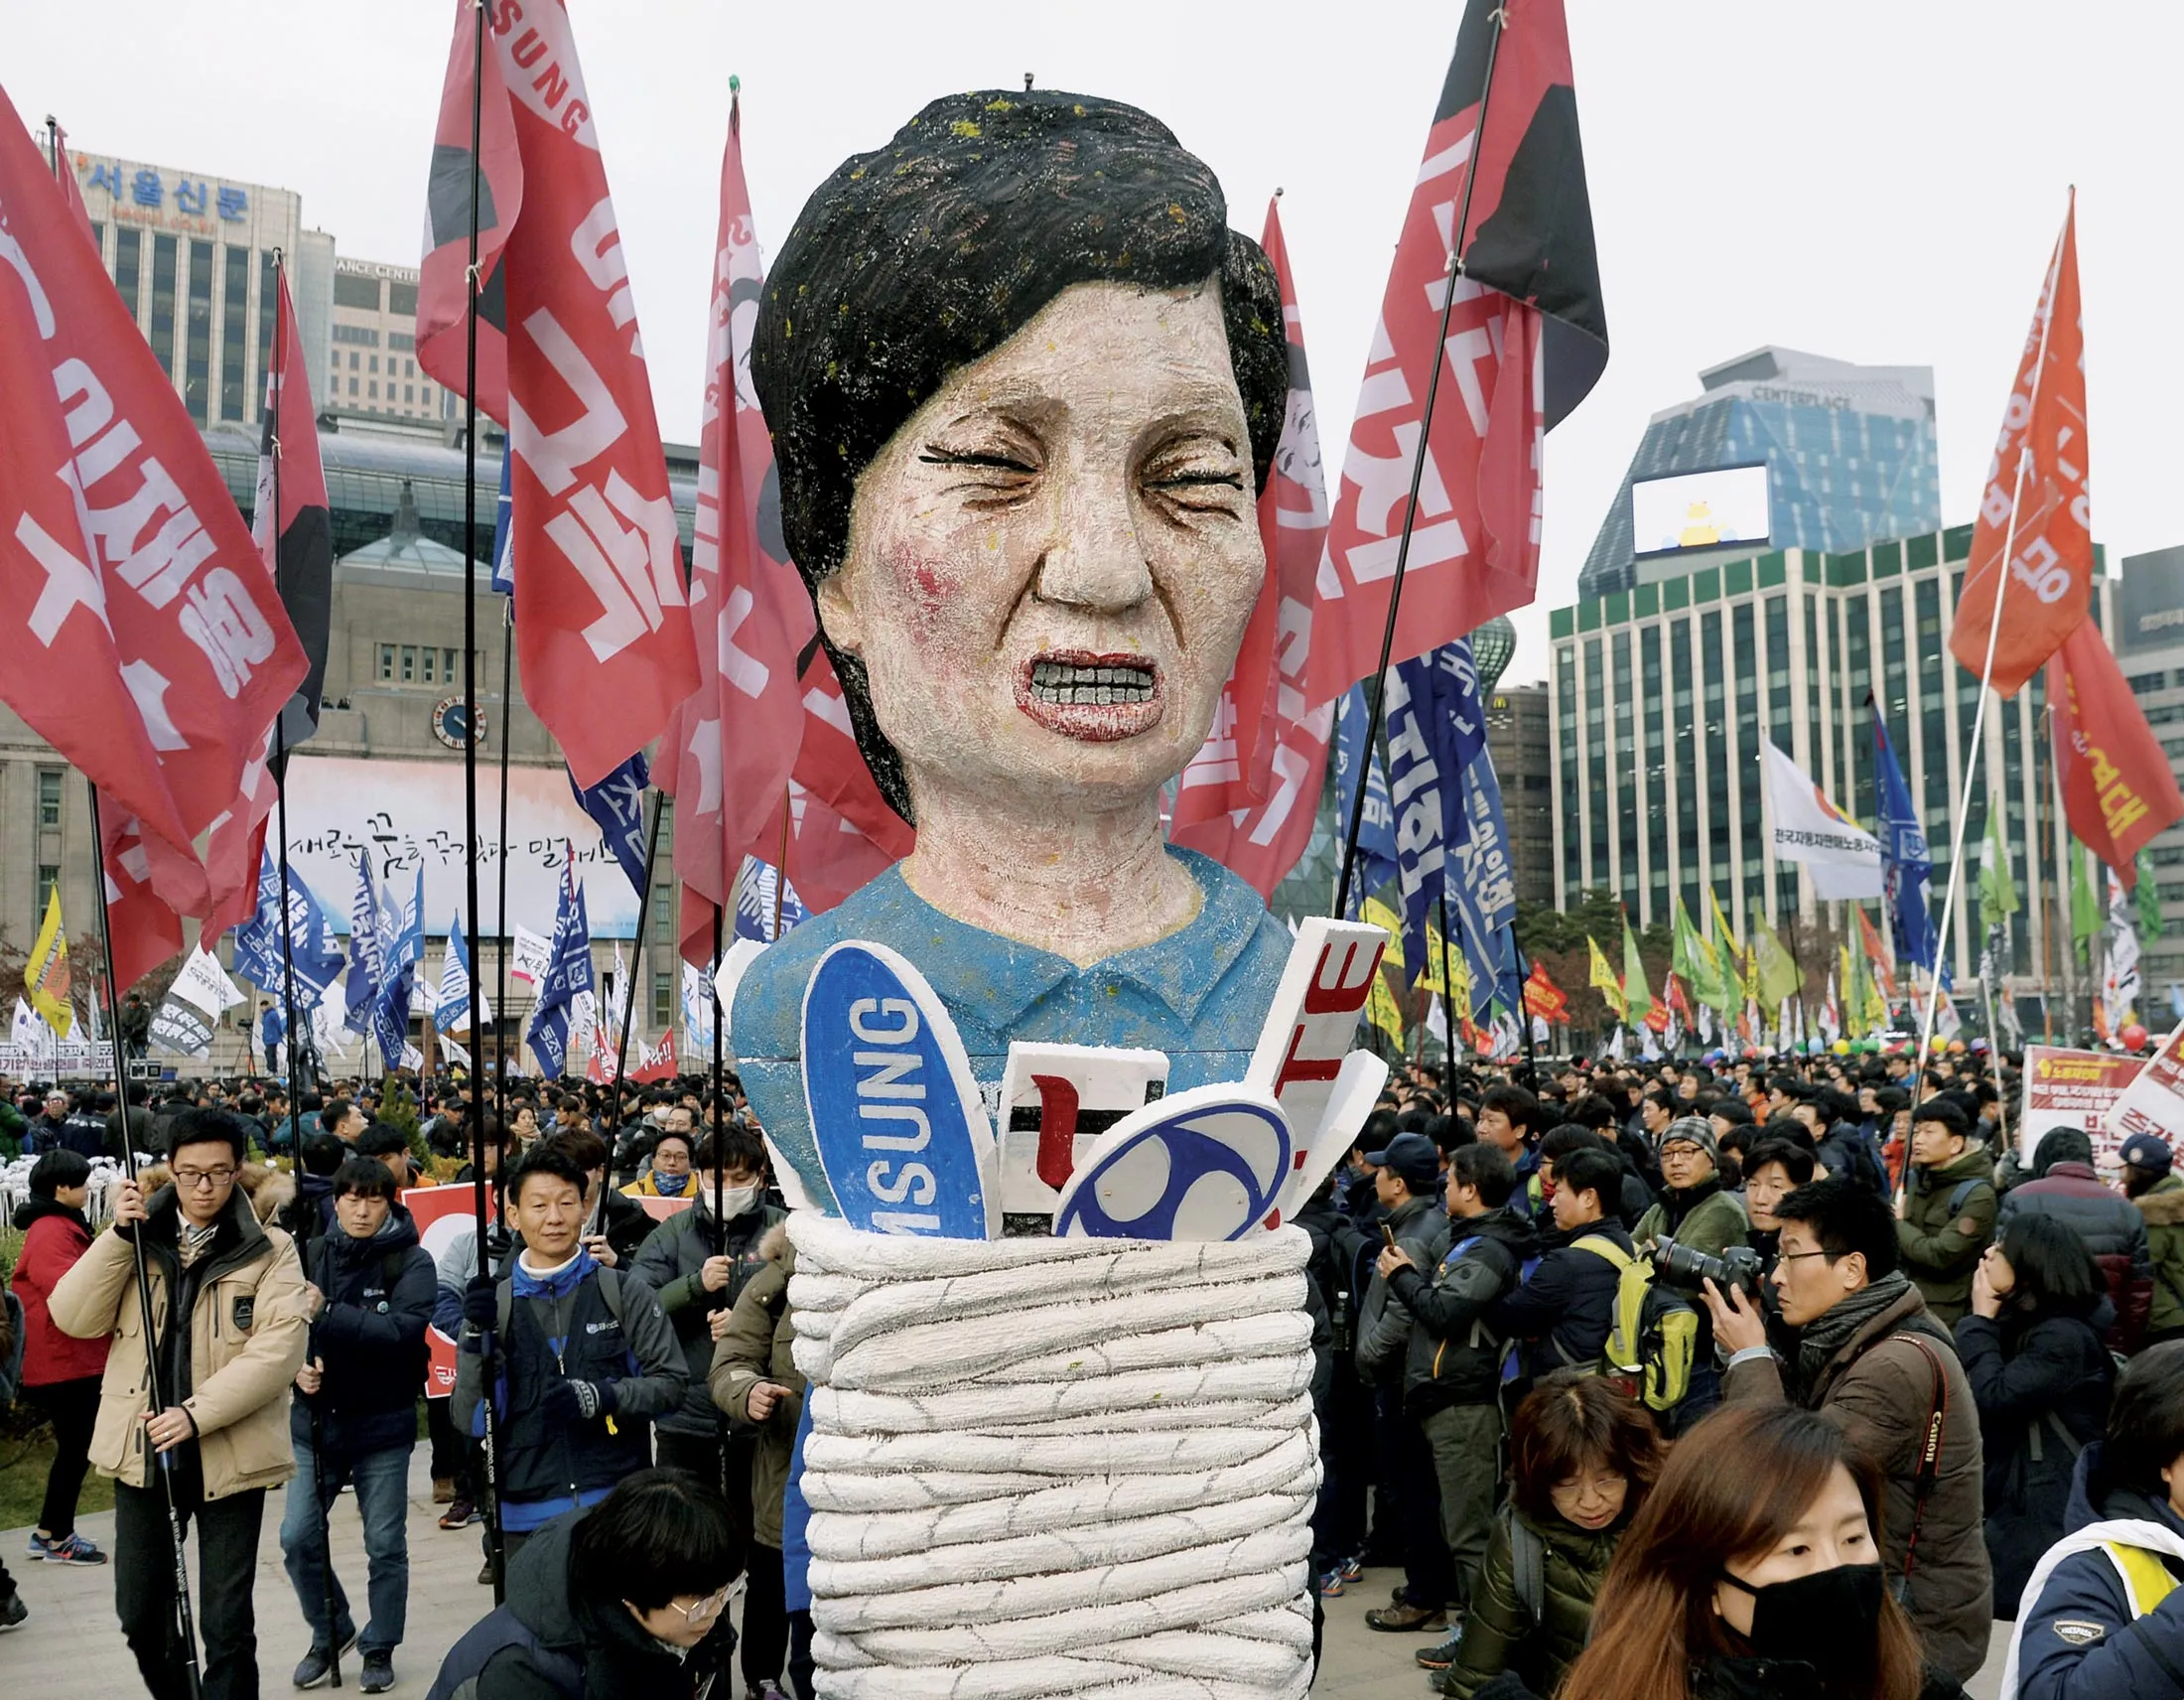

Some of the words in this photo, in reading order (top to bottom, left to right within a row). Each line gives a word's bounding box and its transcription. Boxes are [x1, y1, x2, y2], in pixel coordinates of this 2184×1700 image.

[88, 163, 247, 223] 서울신문
[376, 263, 421, 282] CENTE
[289, 829, 364, 869] 새로운
[367, 812, 425, 879] 꿈을
[538, 1024, 564, 1068] 동조합
[1925, 1411, 1942, 1463] Canon
